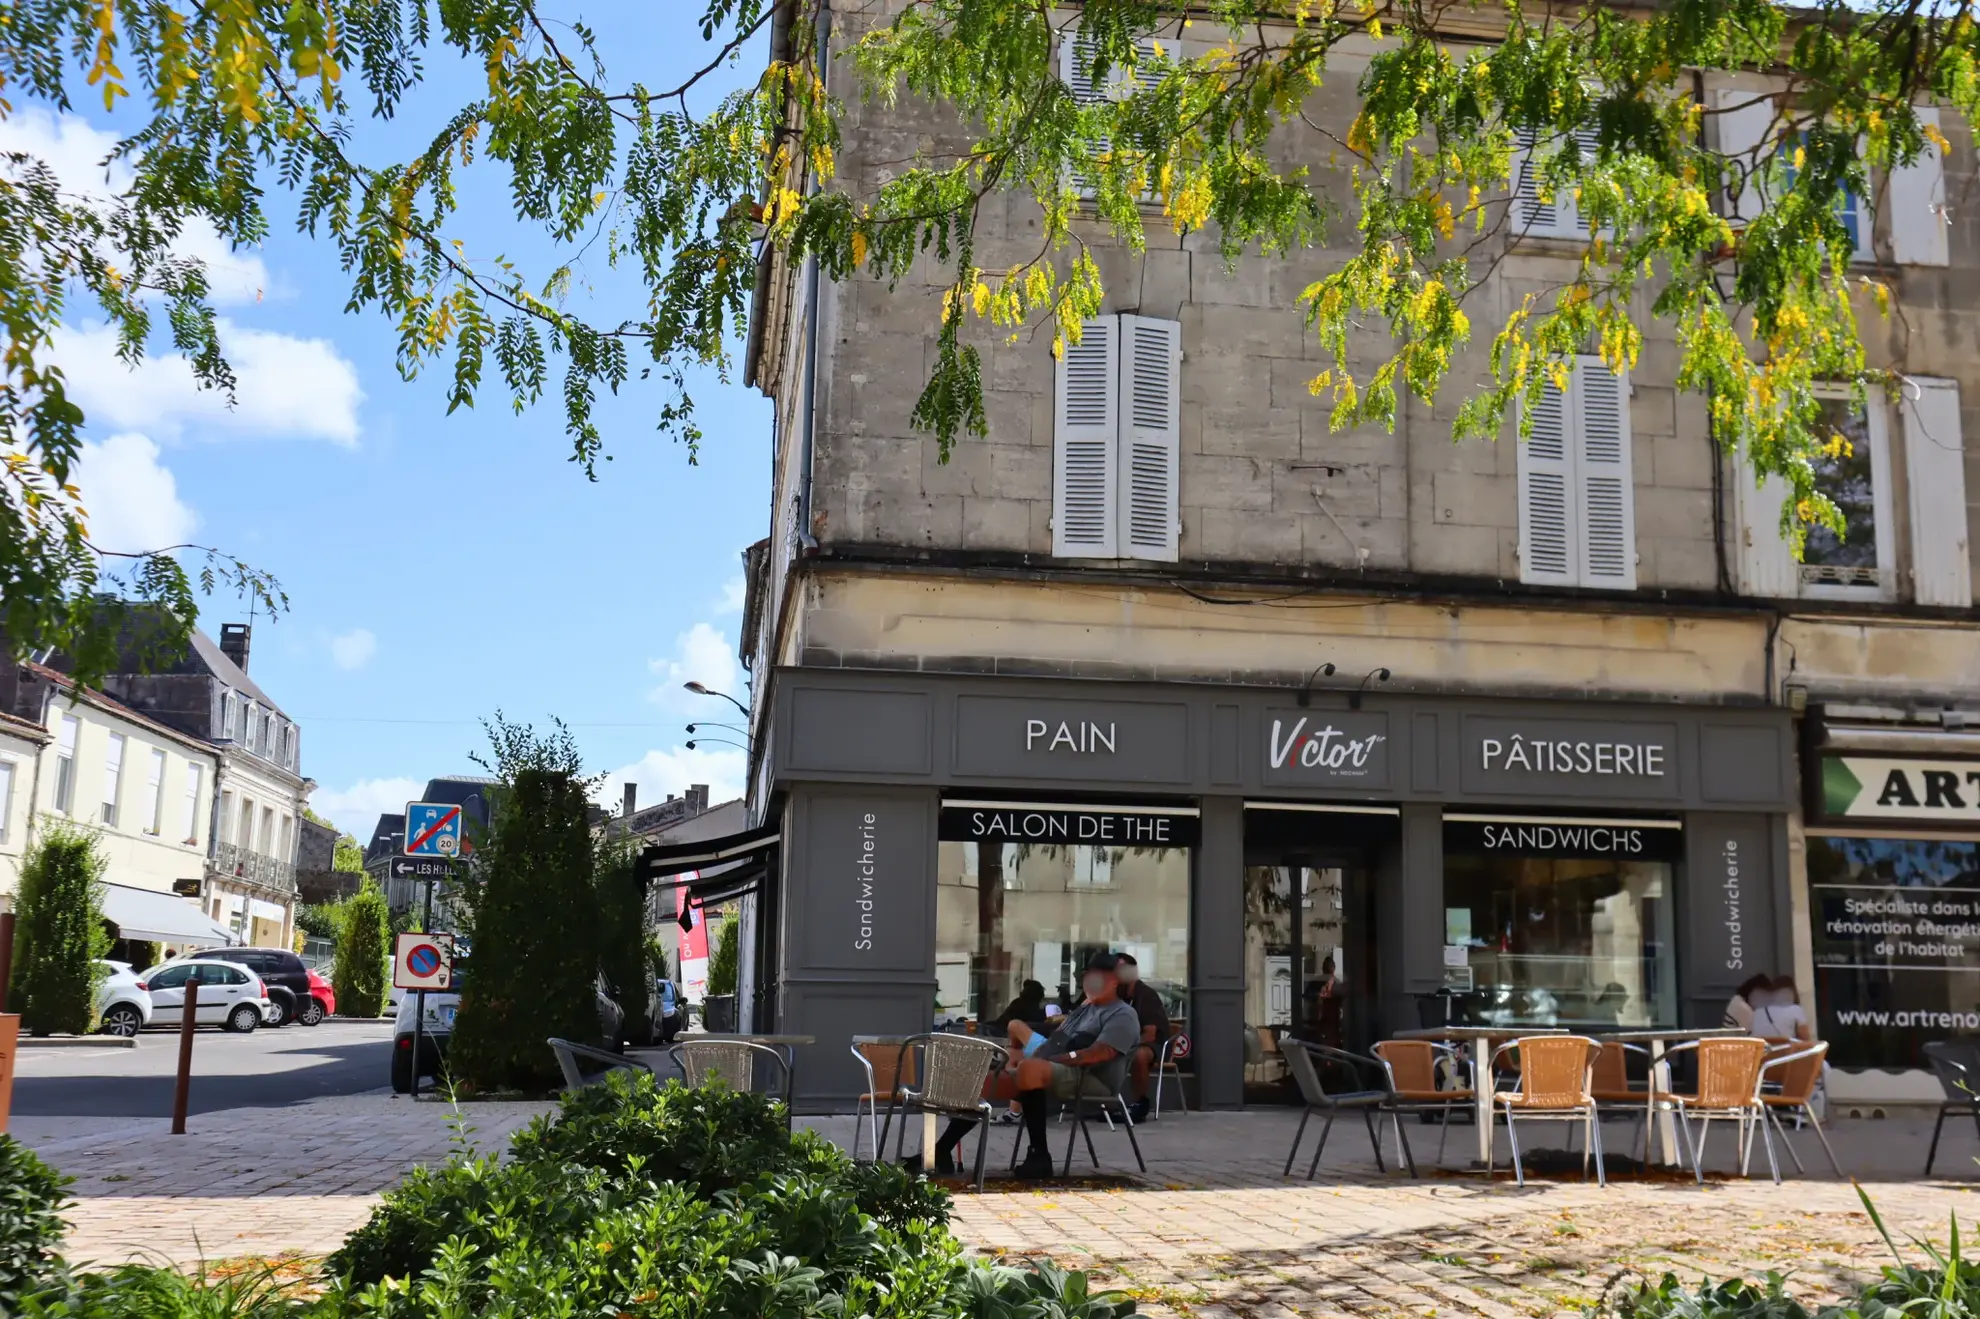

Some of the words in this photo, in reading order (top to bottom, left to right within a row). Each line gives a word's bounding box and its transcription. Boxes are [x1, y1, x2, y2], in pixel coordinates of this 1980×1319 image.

[1026, 719, 1116, 753] PAIN
[1271, 717, 1367, 768] Victor
[1482, 733, 1665, 776] PÂTISSERIE
[972, 812, 1068, 836] SALON
[1078, 815, 1114, 839] DE
[1122, 817, 1170, 841] THE
[1483, 825, 1643, 852] SANDWICHS
[440, 840, 451, 848] 20
[416, 863, 432, 875] LES
[855, 812, 876, 950] Sandwicherie
[1722, 840, 1743, 969] Sandwicherie
[1844, 898, 1928, 916] Spécialiste
[1932, 901, 1970, 915] dans
[1826, 918, 1912, 935] rénovation
[1874, 943, 1895, 955] de
[1899, 942, 1965, 957] l'habitat
[1836, 1009, 1980, 1028] www.artreno
